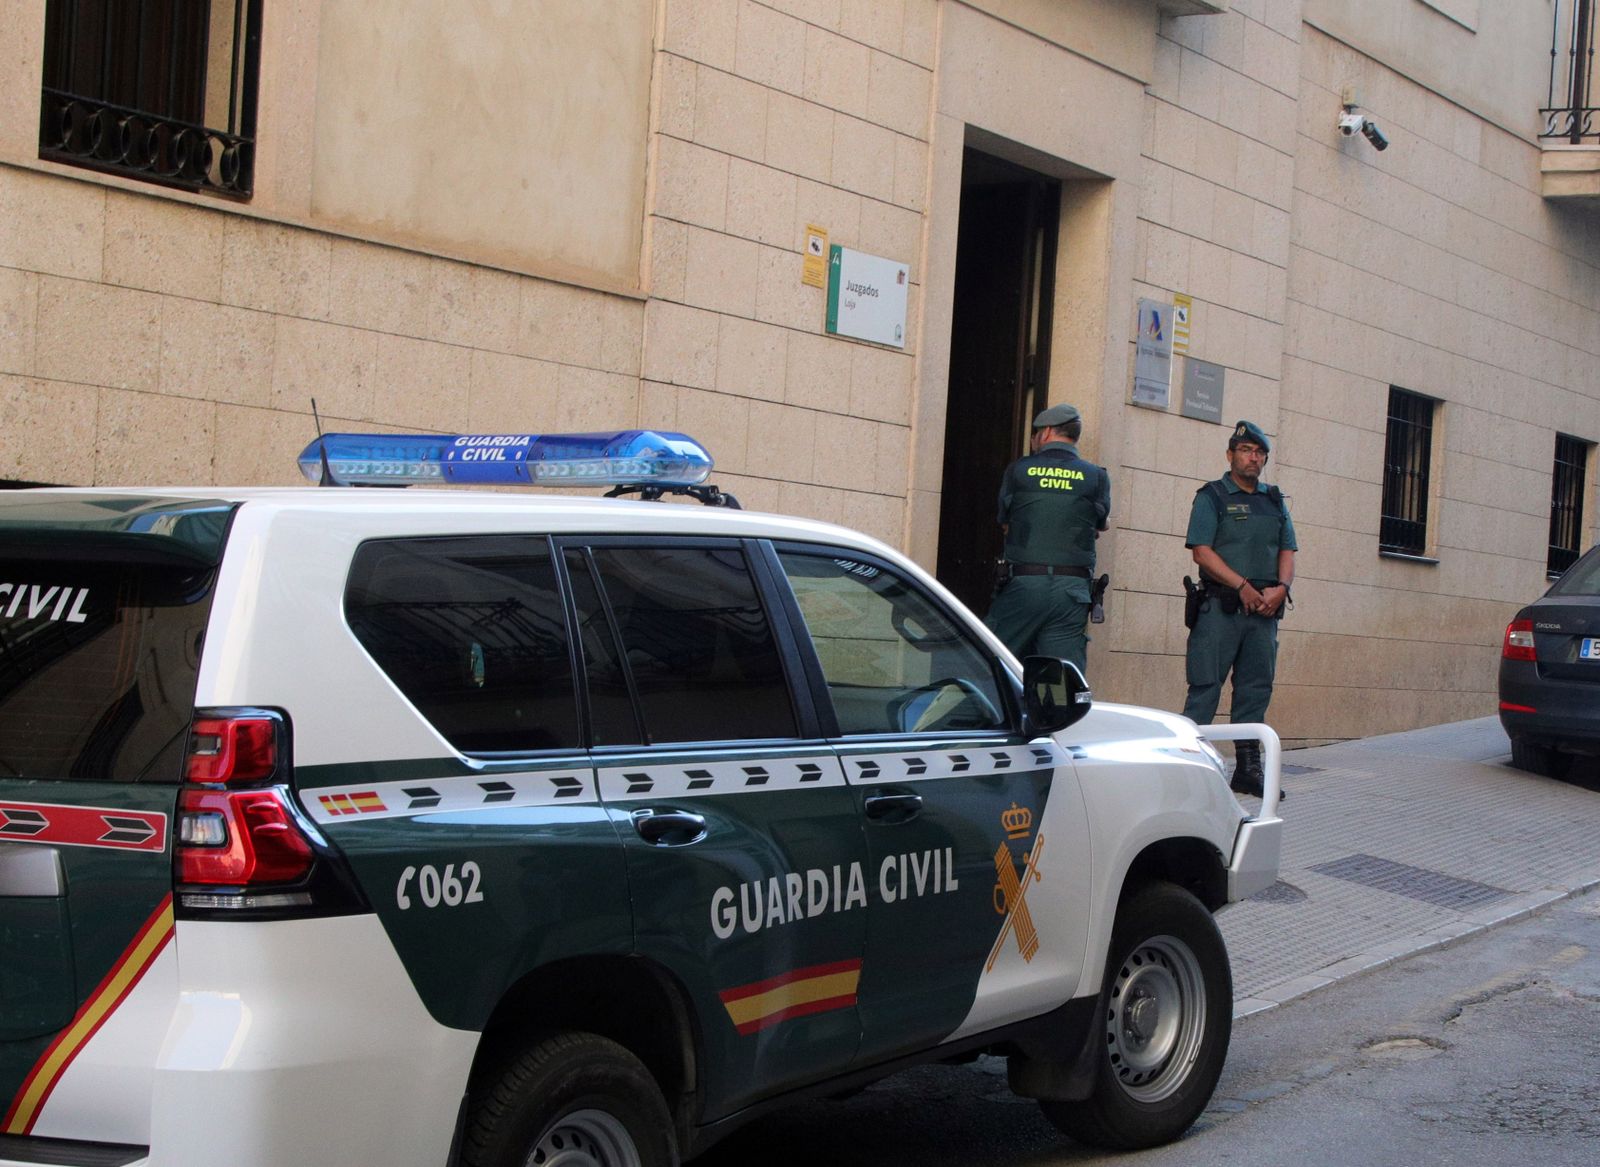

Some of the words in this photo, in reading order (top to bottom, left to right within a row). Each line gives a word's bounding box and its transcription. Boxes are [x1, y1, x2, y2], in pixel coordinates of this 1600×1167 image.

[845, 280, 879, 298] Juzgados
[454, 436, 530, 446] GUARDIA
[461, 448, 507, 461] CIVIL
[1027, 467, 1084, 480] GUARDIA
[1039, 478, 1073, 490] CIVIL
[419, 861, 483, 908] 062
[711, 861, 868, 940] GUARDIA
[879, 846, 960, 903] CIVIL
